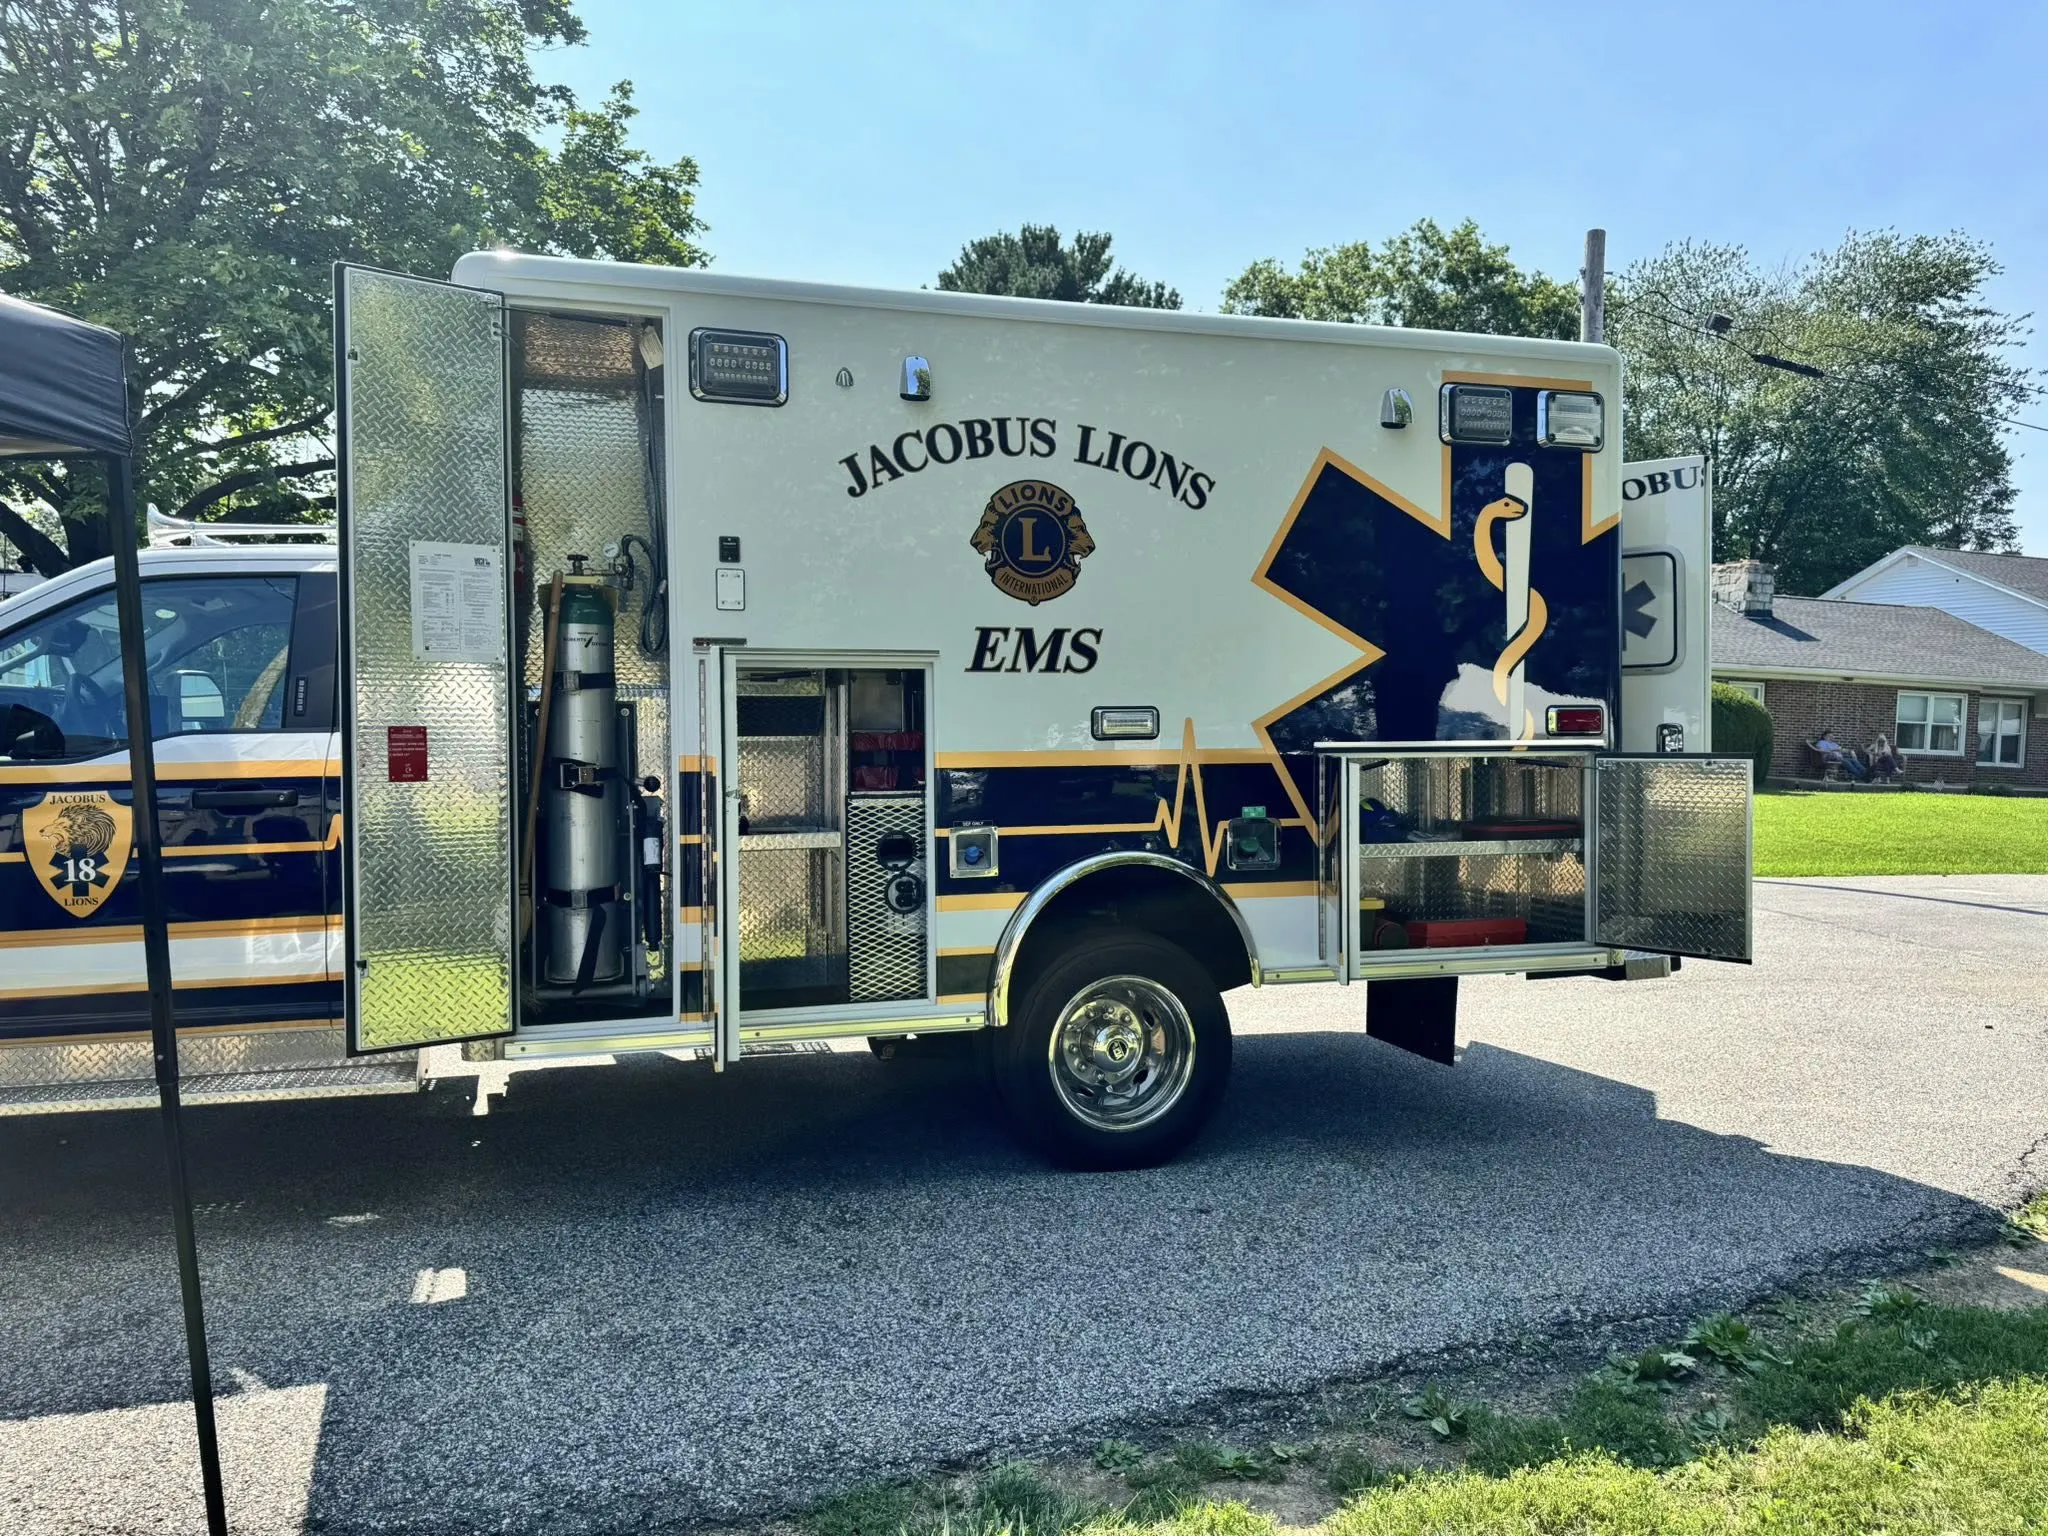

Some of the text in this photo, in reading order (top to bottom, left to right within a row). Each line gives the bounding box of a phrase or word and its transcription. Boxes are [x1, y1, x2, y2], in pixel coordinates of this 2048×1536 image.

[839, 416, 1217, 511] JACOBUS LIONS
[998, 484, 1069, 511] LIONS
[1018, 517, 1052, 562] L
[998, 571, 1069, 595] INTERNATIONAL
[963, 626, 1104, 675] EMS
[49, 793, 106, 805] JACOBUS
[63, 858, 97, 883] 18
[64, 897, 99, 907] LIONS
